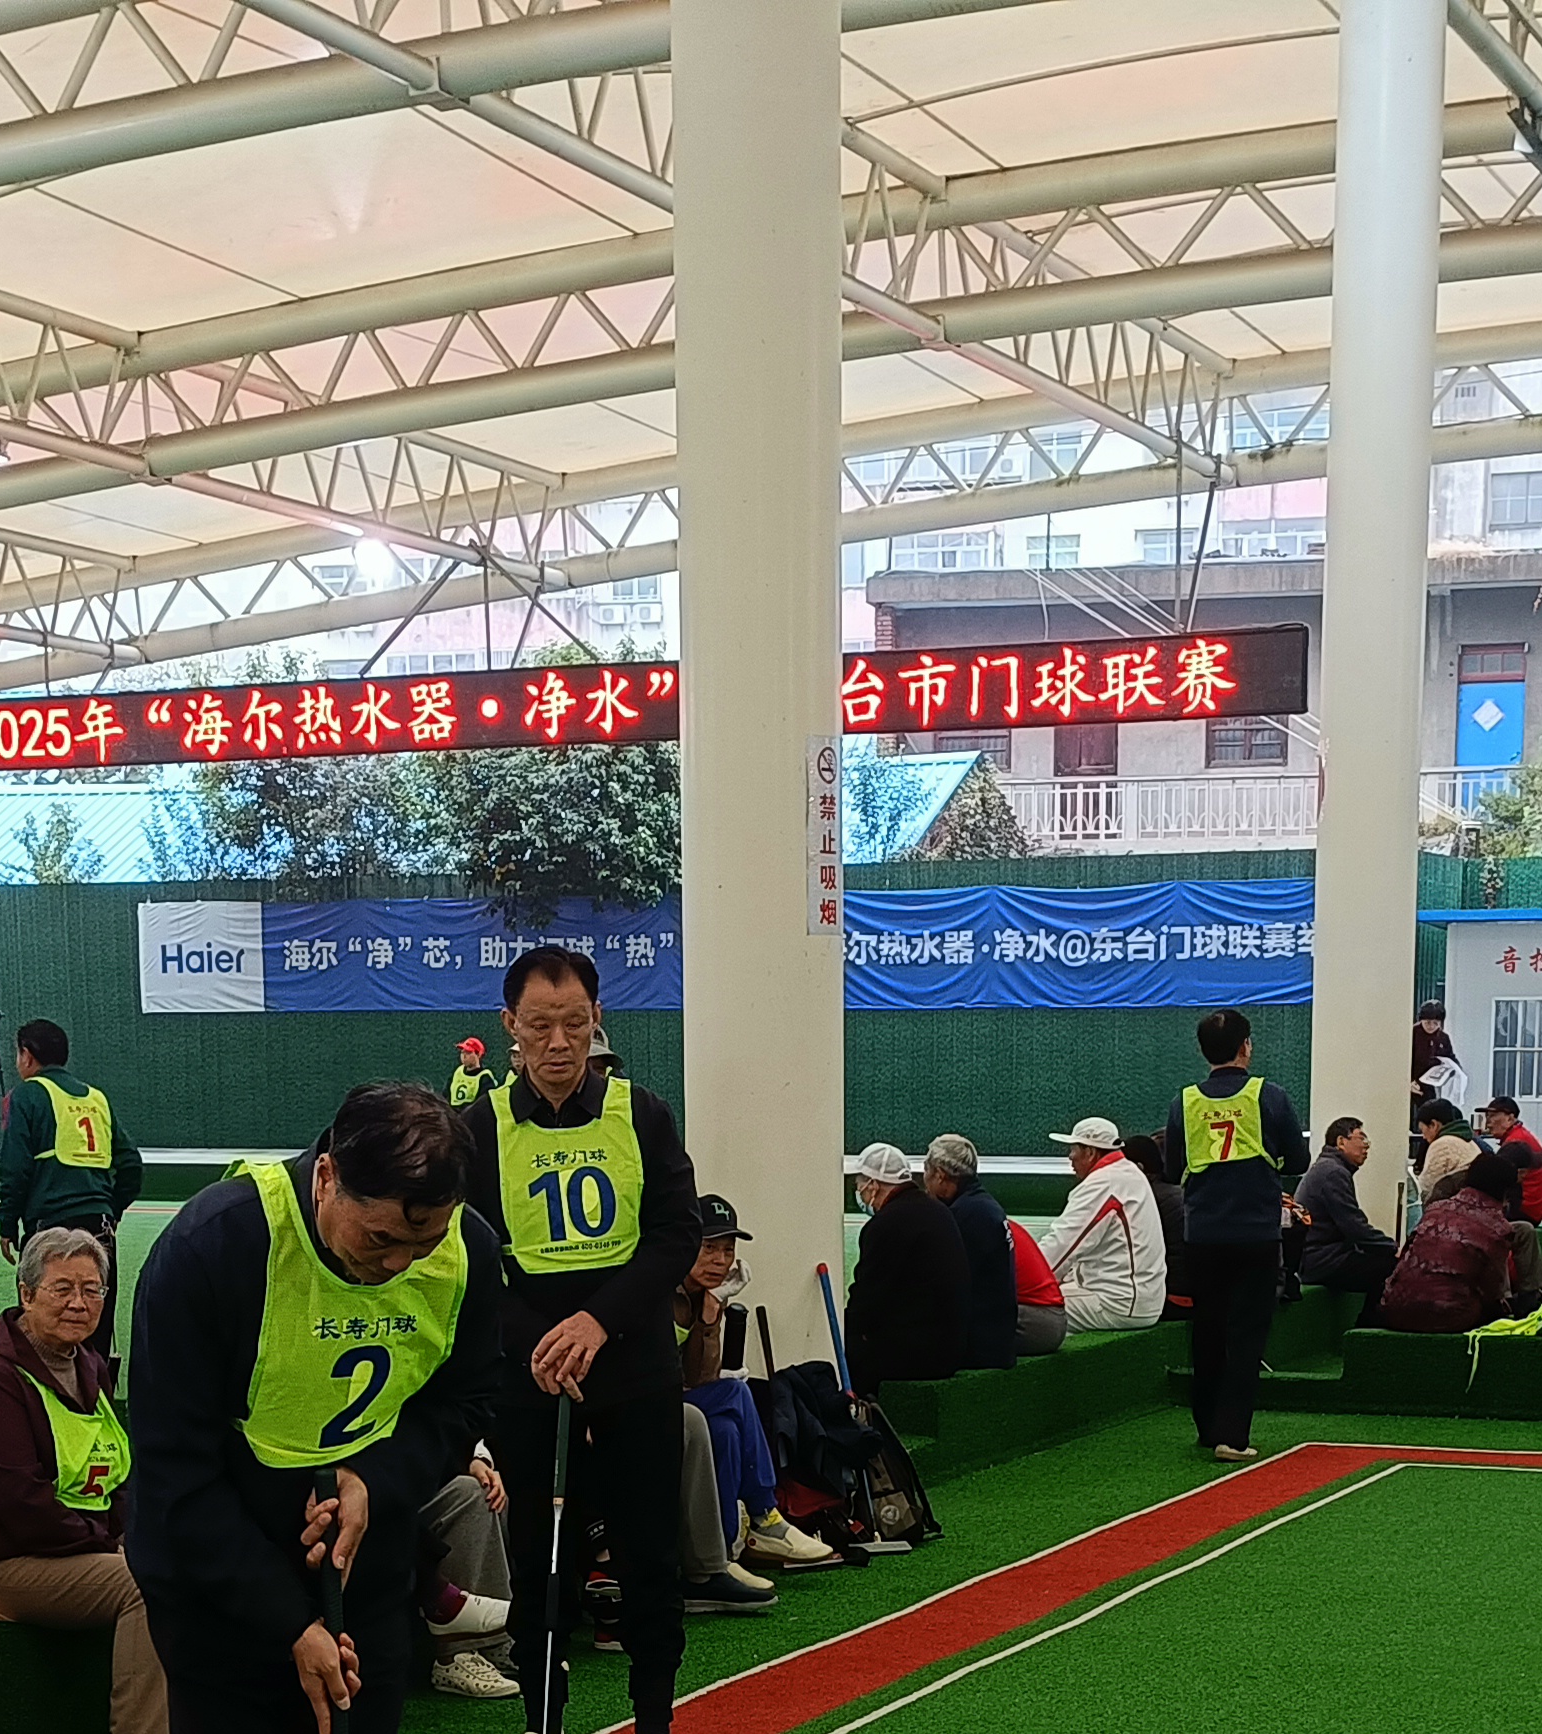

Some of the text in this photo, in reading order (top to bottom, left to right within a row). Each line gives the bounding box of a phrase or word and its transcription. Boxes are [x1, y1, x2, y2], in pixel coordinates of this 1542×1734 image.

[819, 793, 837, 926] 禁止吸烟
[160, 941, 245, 974] Haier
[455, 1084, 467, 1100] 6
[78, 1116, 95, 1152] 1
[1210, 1120, 1235, 1160] 7
[531, 1148, 608, 1168] 长寿门球
[528, 1165, 617, 1242] 10
[314, 1314, 418, 1340] 长寿门球
[318, 1345, 391, 1450] 2
[78, 1465, 110, 1497] 5
